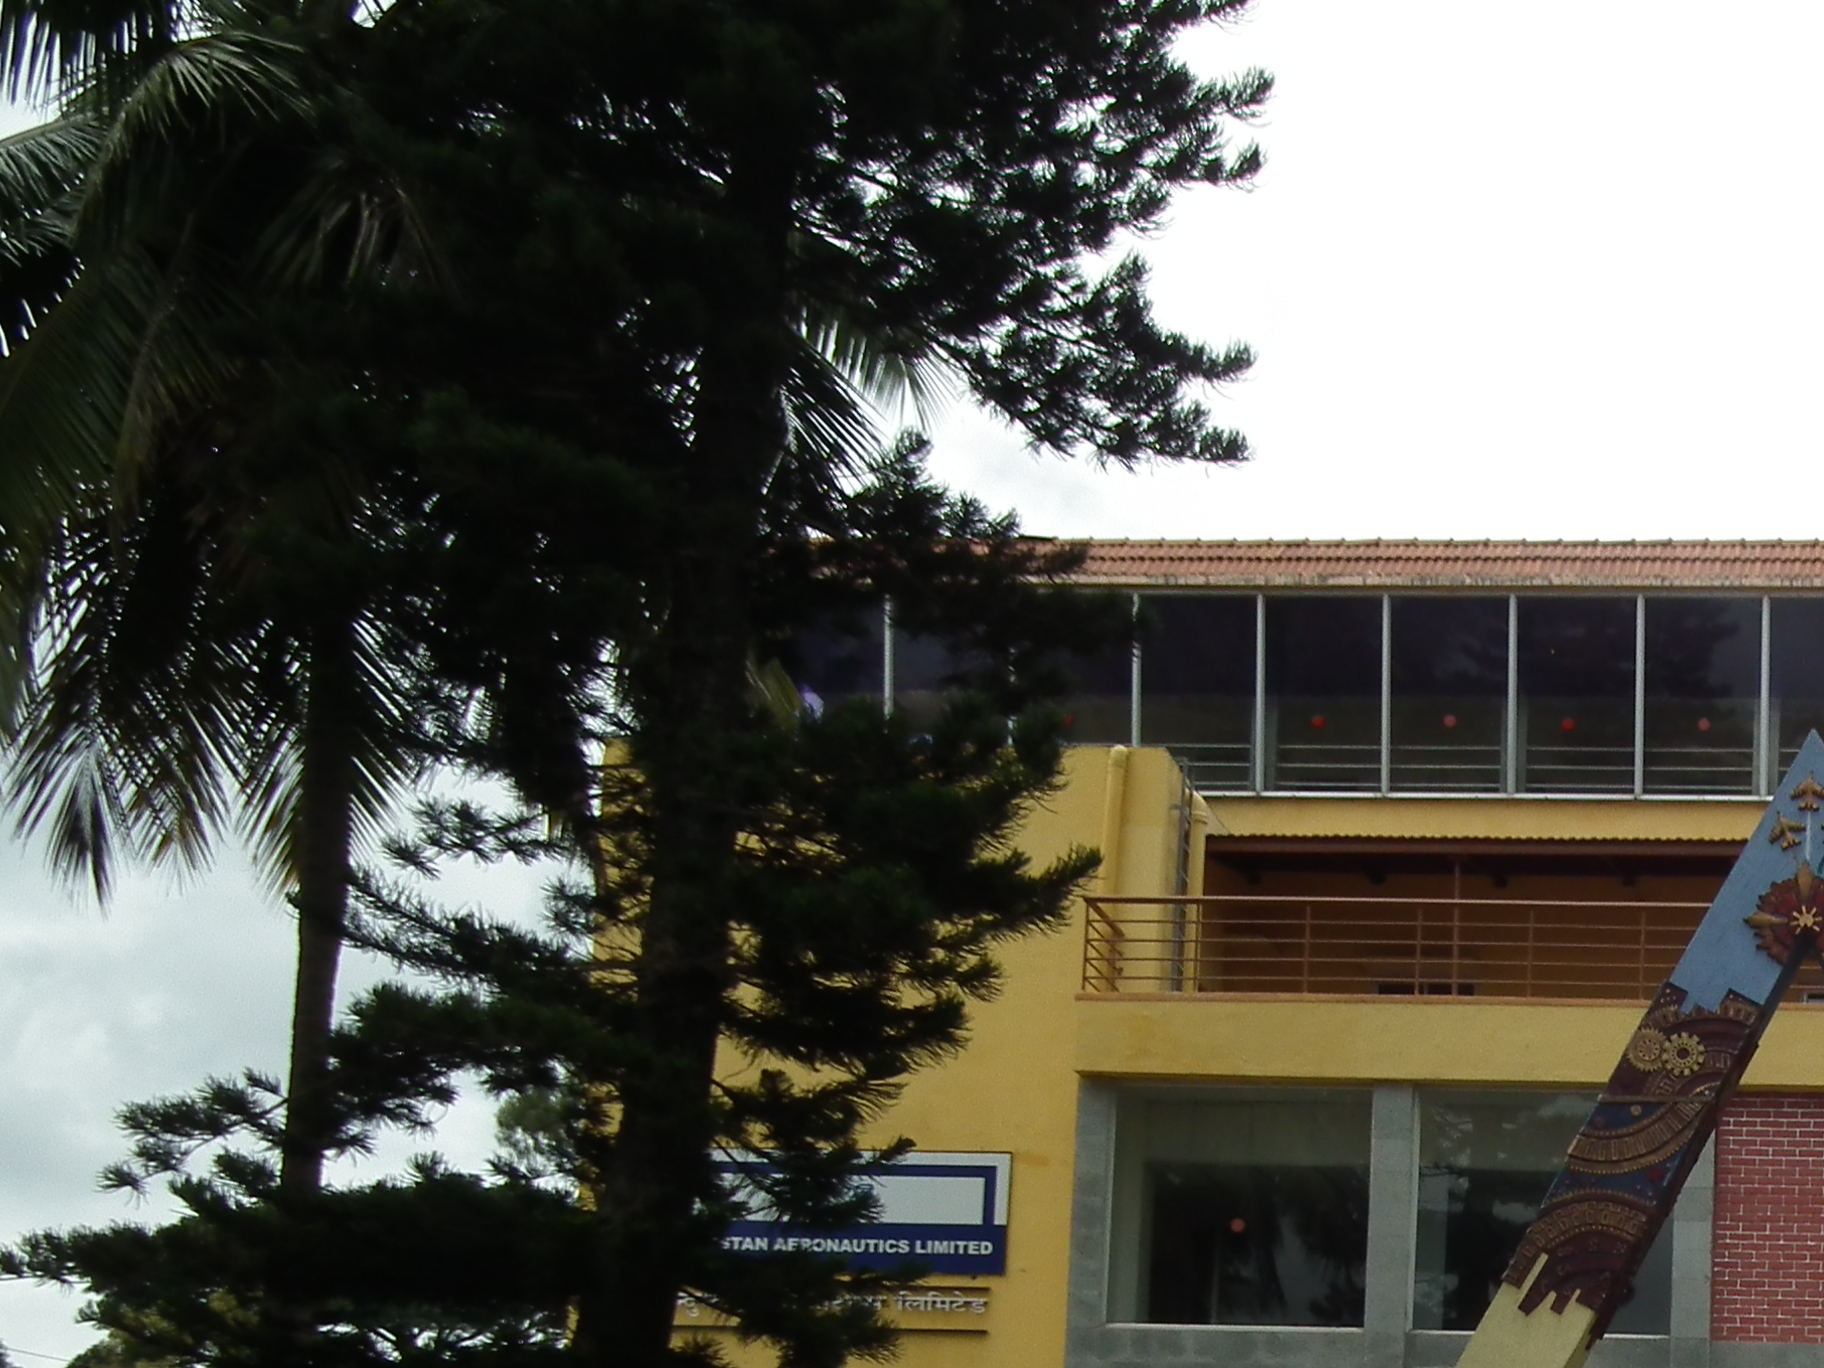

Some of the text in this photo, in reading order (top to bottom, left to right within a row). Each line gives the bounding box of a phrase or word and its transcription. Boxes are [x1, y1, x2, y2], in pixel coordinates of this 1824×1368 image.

[712, 1235, 994, 1255] STAN AERONAUTICS LIMITED
[896, 1290, 988, 1313] लिमिटेड
